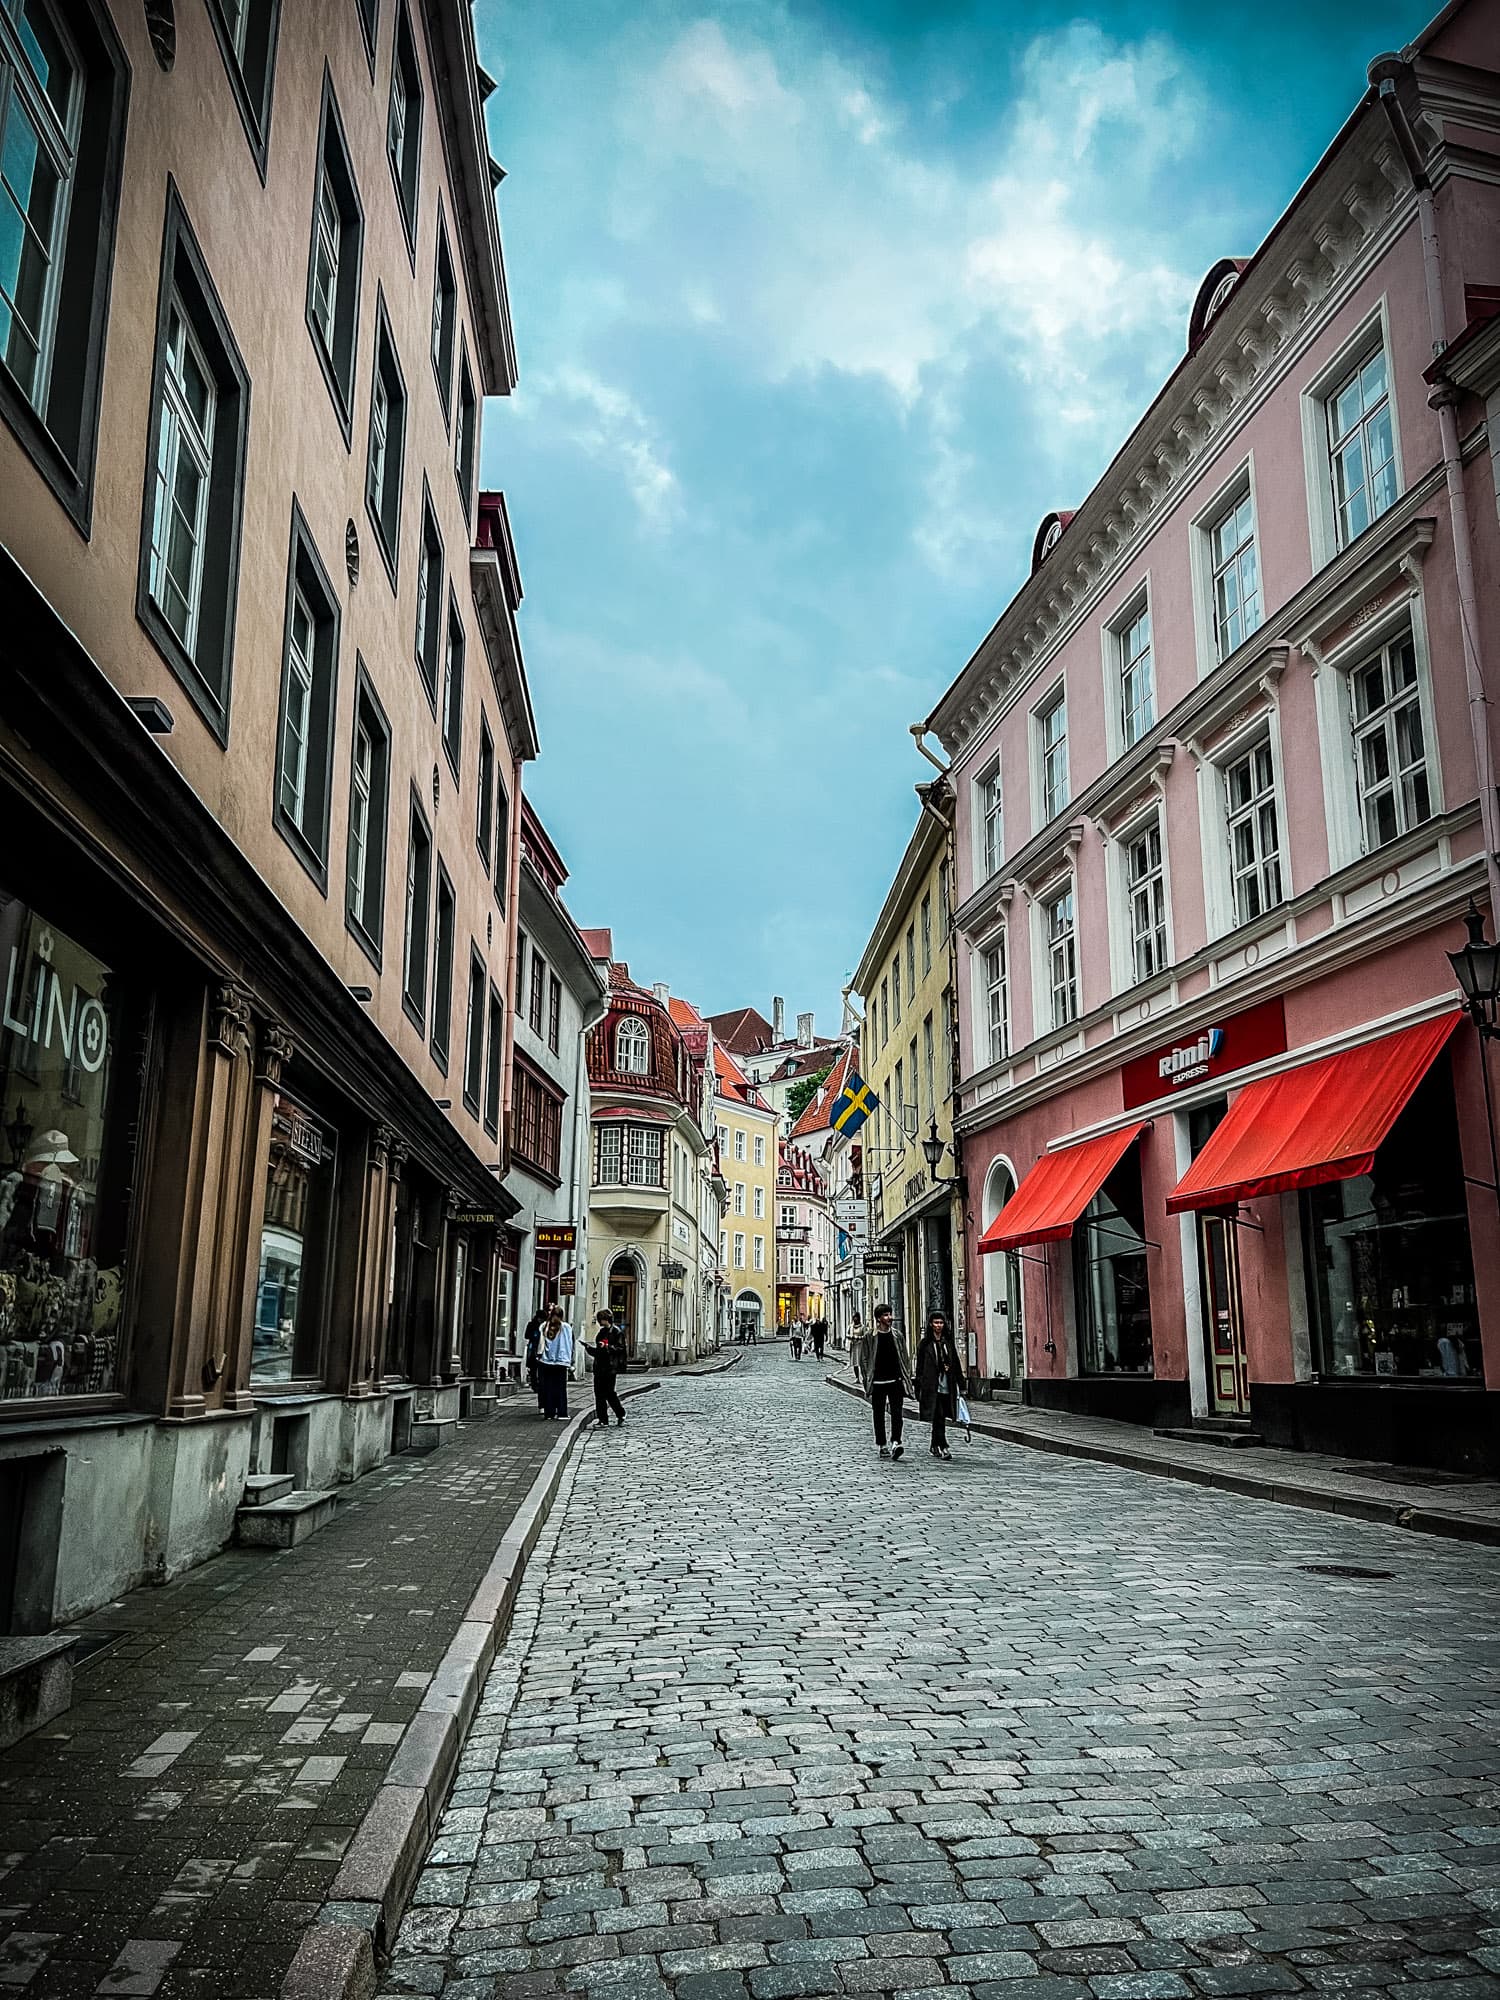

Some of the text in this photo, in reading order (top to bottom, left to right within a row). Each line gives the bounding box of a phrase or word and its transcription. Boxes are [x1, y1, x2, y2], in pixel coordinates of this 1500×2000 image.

[1172, 1065, 1209, 1084] EXPRESS
[456, 1214, 495, 1223] SOUVENIR
[538, 1233, 551, 1241] Oh
